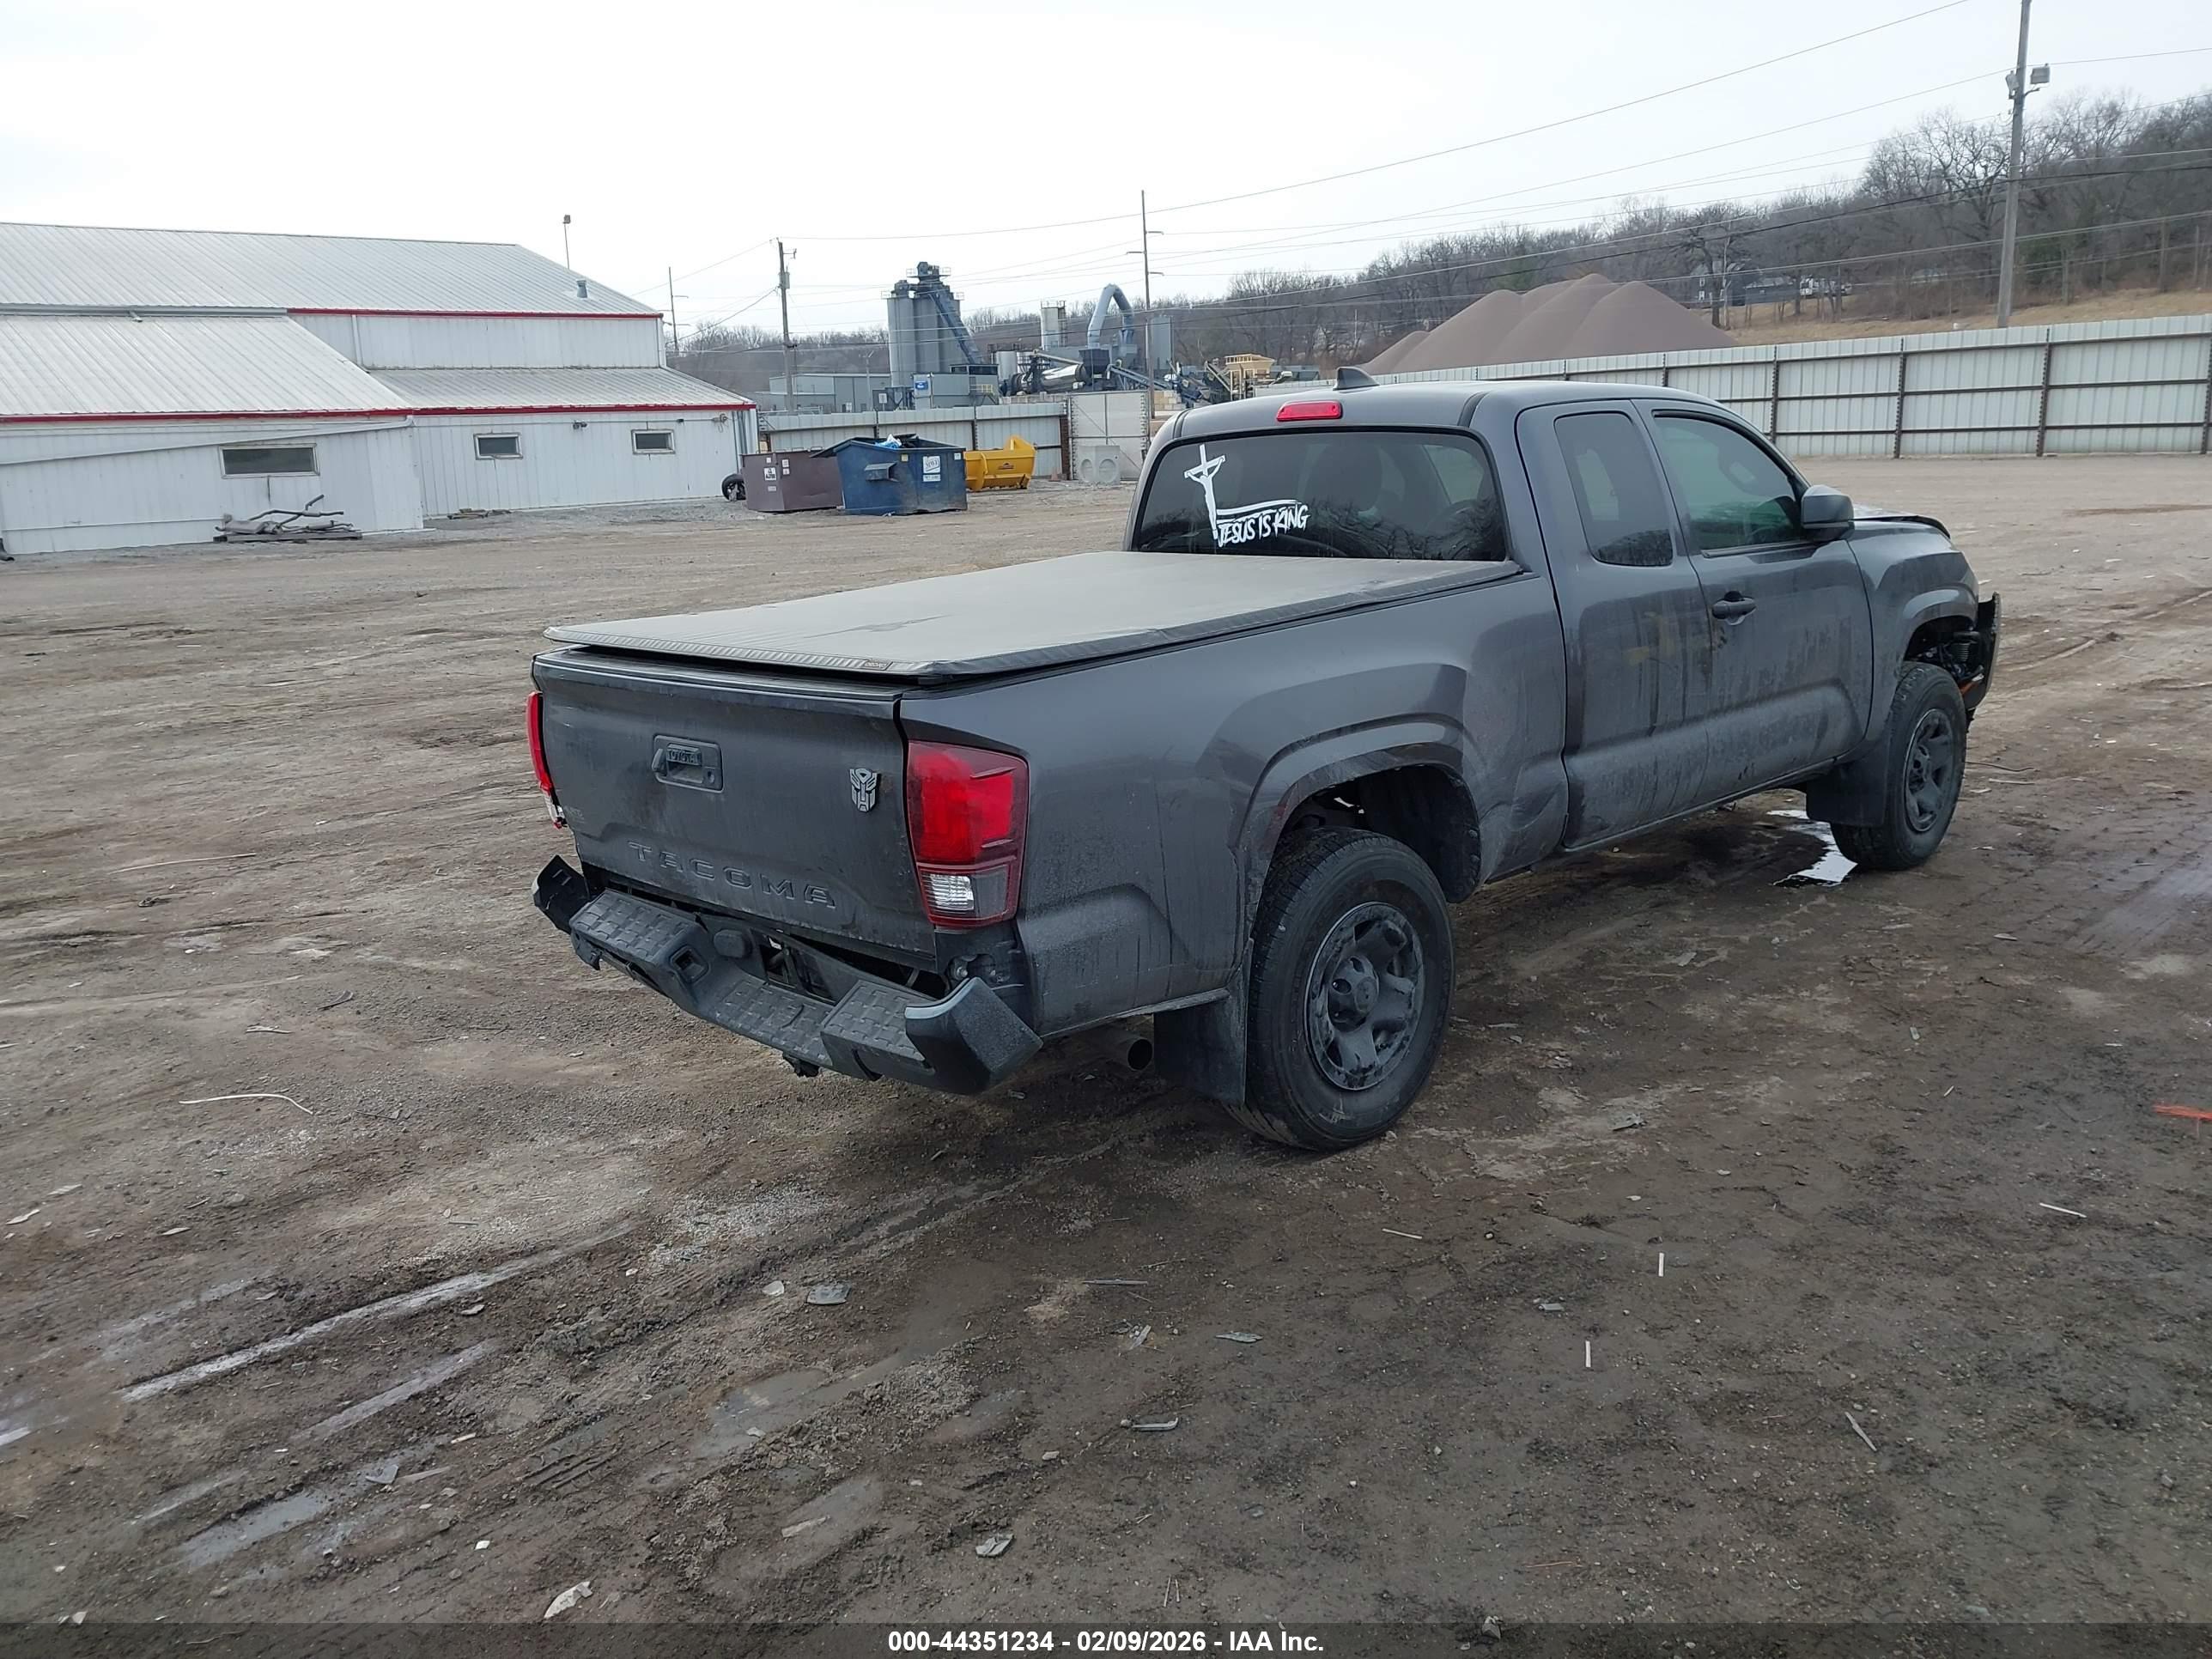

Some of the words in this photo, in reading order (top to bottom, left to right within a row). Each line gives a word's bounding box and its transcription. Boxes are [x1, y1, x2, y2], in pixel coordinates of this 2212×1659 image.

[1217, 518, 1255, 547] JESUS
[1258, 514, 1272, 540] IS
[1272, 503, 1310, 538] KING
[627, 840, 836, 909] TACOMA
